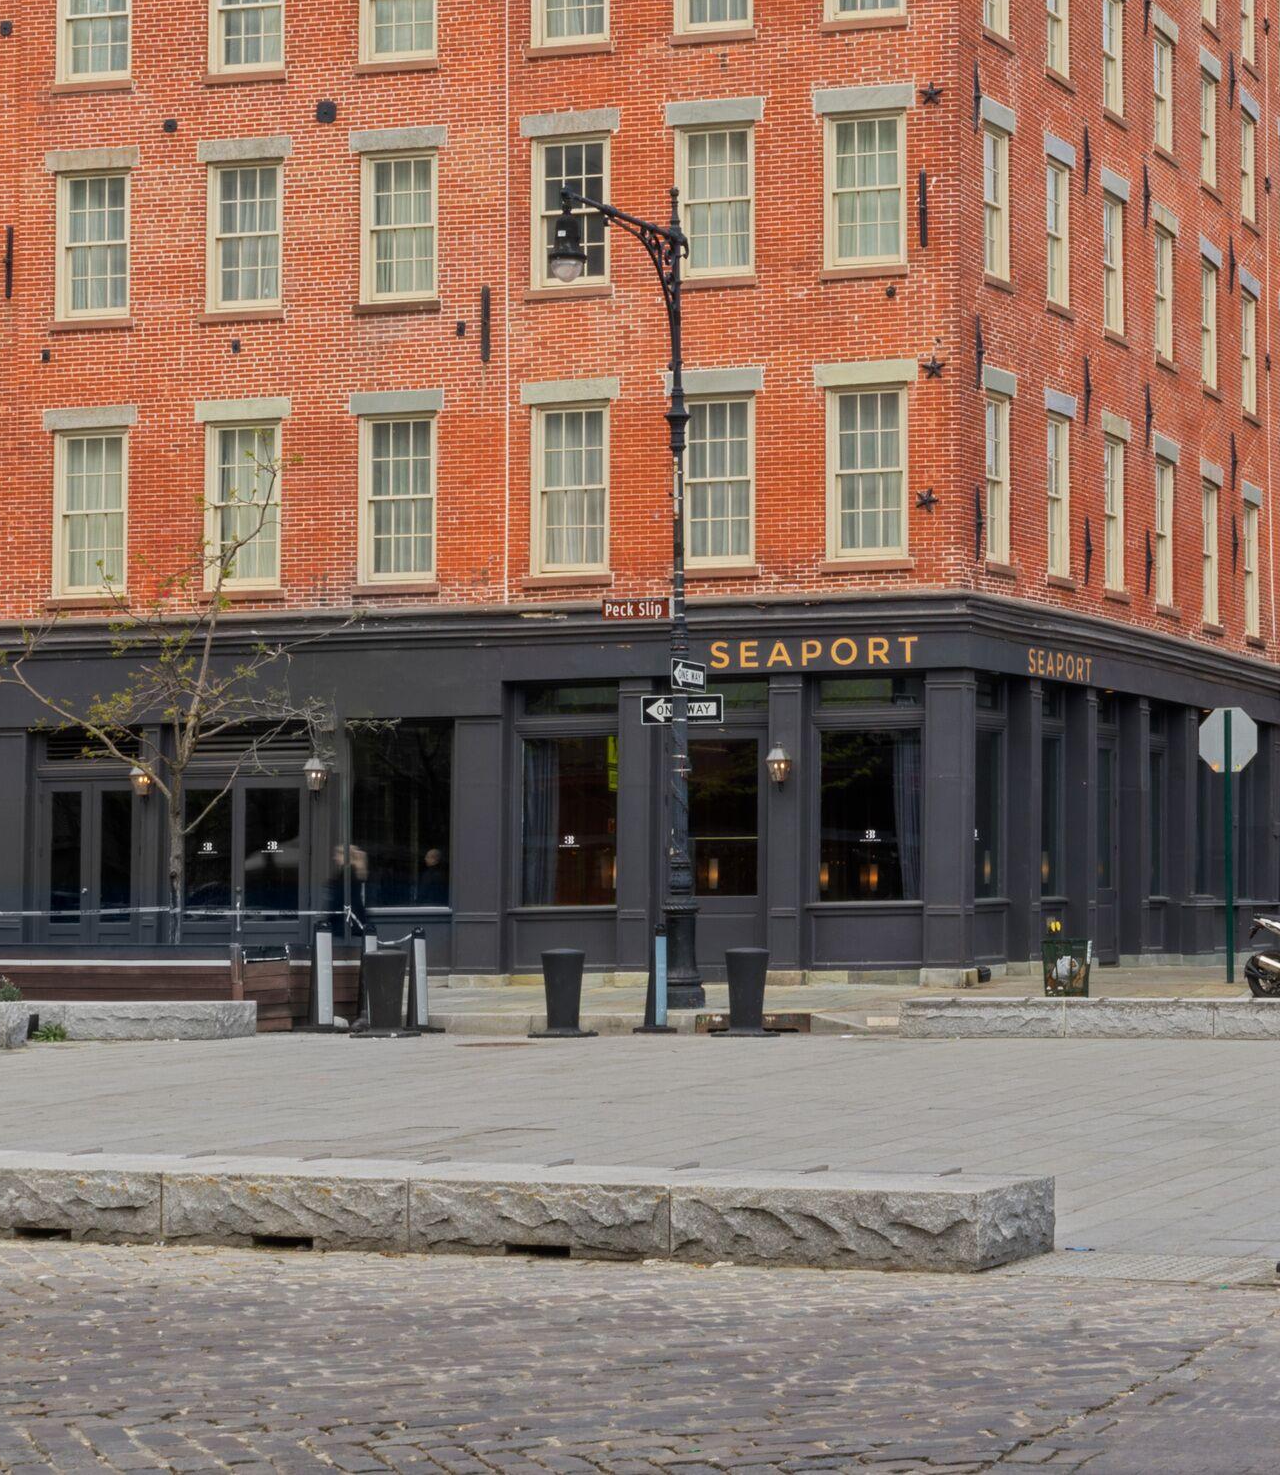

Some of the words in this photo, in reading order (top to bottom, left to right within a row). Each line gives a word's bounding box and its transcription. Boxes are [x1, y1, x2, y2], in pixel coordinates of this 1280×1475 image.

[605, 602, 634, 617] Peck
[638, 602, 662, 620] Slip
[709, 636, 919, 669] SEAPORT
[1028, 647, 1093, 683] SEAPORT
[677, 671, 689, 682] ONE
[691, 672, 703, 682] WAY
[656, 705, 672, 716] ON
[687, 704, 711, 714] WAY
